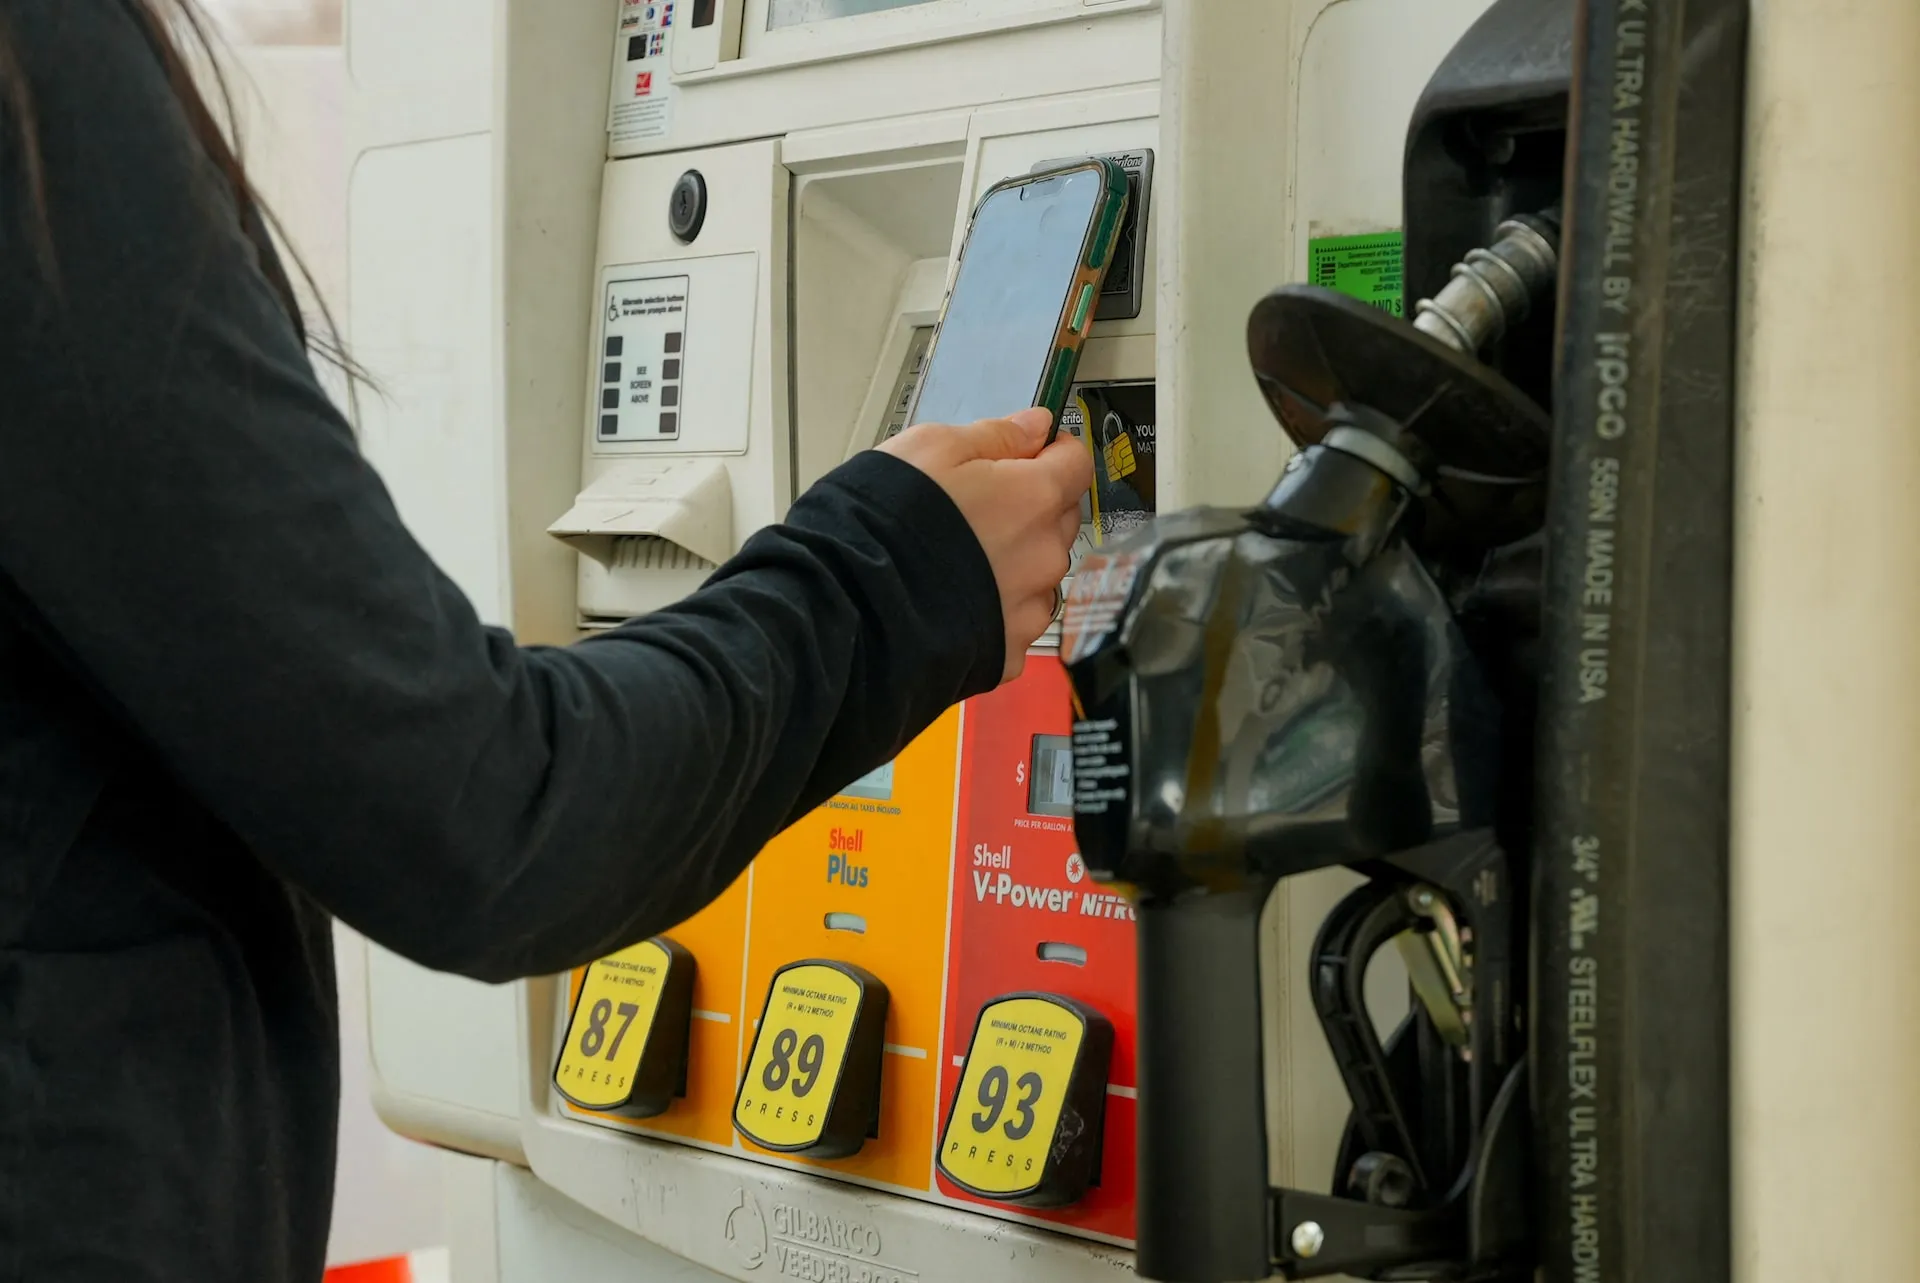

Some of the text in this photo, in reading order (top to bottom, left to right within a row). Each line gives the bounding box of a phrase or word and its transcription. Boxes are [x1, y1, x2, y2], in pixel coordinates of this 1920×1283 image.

[1614, 20, 1647, 111] ULTRA
[1603, 117, 1640, 272] HARDWALL
[1602, 276, 1632, 315] BY
[630, 380, 652, 389] SCREEN
[636, 366, 647, 375] SEE
[631, 394, 649, 403] ABOVE
[1583, 528, 1616, 606] MADE
[1581, 613, 1611, 642] IN
[1578, 648, 1609, 703] USA
[1015, 760, 1025, 786] $
[829, 827, 863, 852] Shell
[1014, 818, 1030, 828] PRICE
[1030, 820, 1042, 829] PER
[1042, 821, 1066, 832] GALLON
[827, 852, 869, 888] Plus
[973, 843, 1011, 869] Shell
[972, 870, 1074, 913] V-Power
[783, 985, 848, 1005] MINIMUM OCTANE RATING
[811, 1006, 834, 1018] METHOD
[580, 998, 640, 1062] 87
[991, 1019, 1067, 1041] MINIMUM OCTANE RATING
[1568, 956, 1598, 1100] STEELFLEX
[1025, 1042, 1052, 1054] METHOD
[563, 1064, 625, 1088] PRESS
[762, 1028, 825, 1098] 89
[744, 1099, 815, 1126] PRESS
[971, 1065, 1043, 1141] 93
[950, 1142, 1033, 1171] PRESS
[1568, 1106, 1598, 1190] ULTRA
[772, 1202, 882, 1257] GILBARCO
[772, 1242, 919, 1283] VEEDER-R
